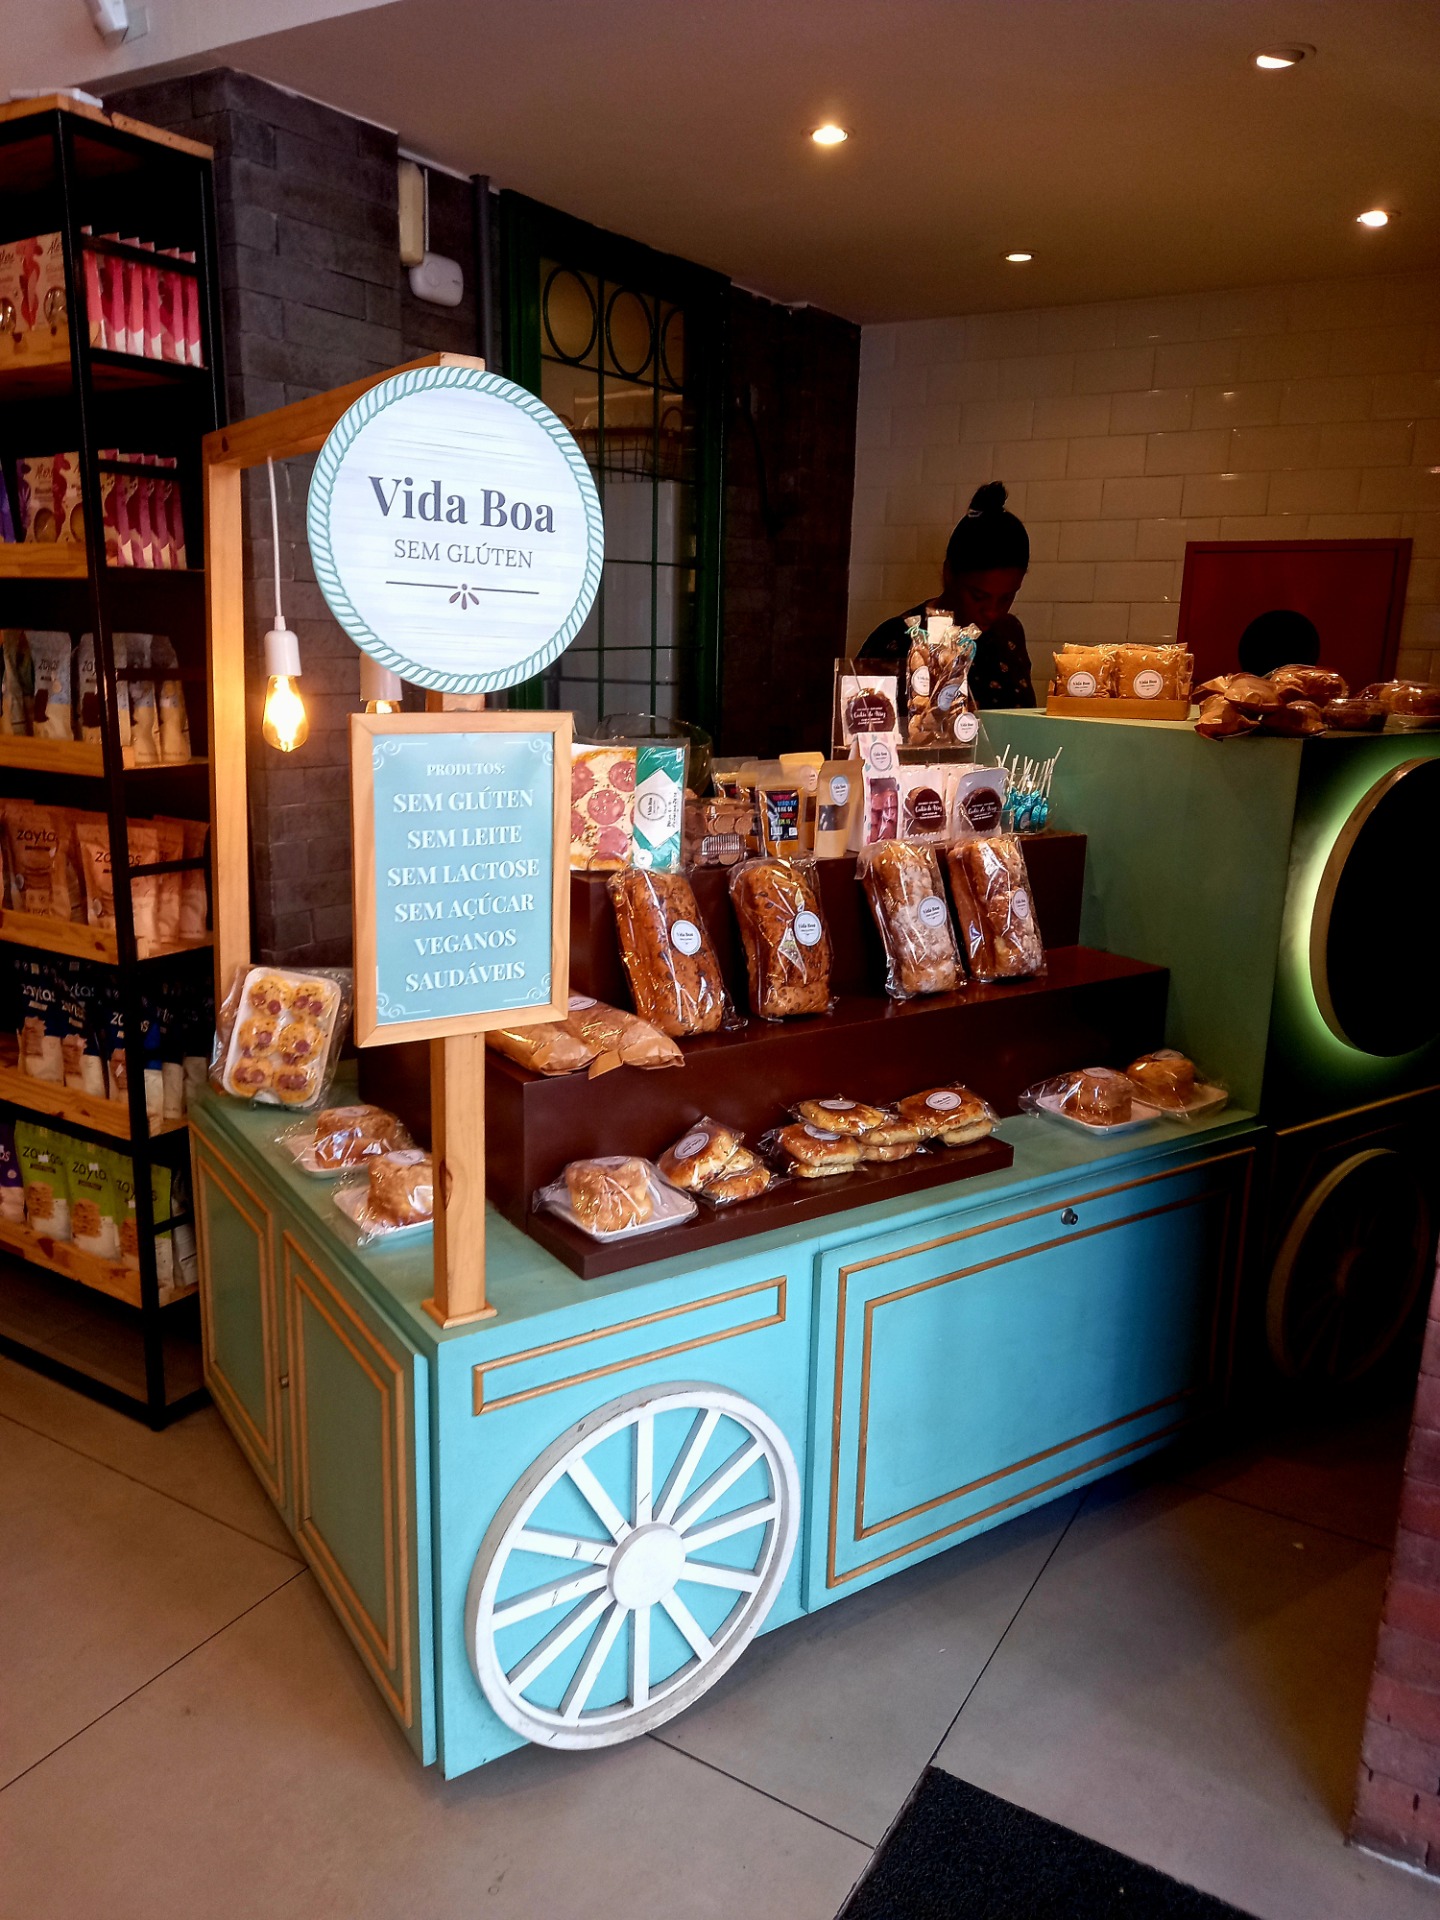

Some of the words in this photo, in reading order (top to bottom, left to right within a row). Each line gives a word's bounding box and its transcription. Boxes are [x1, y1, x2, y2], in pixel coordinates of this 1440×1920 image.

[368, 476, 468, 525] Vida
[480, 488, 556, 533] Boa
[393, 538, 441, 561] SEM
[446, 542, 533, 569] GLÚTEN
[427, 762, 505, 776] PRODUTOS:
[393, 792, 443, 813] SEM
[449, 786, 534, 812] GLÚTEN
[407, 828, 456, 850] SEM
[462, 825, 522, 847] LEITE
[387, 866, 437, 887] SEM
[443, 858, 540, 883] LACTOSE
[394, 902, 443, 923] SEM
[449, 893, 535, 921] AÇÚCAR
[414, 928, 517, 956] VEGANOS
[405, 961, 526, 993] SAUDÁVEIS
